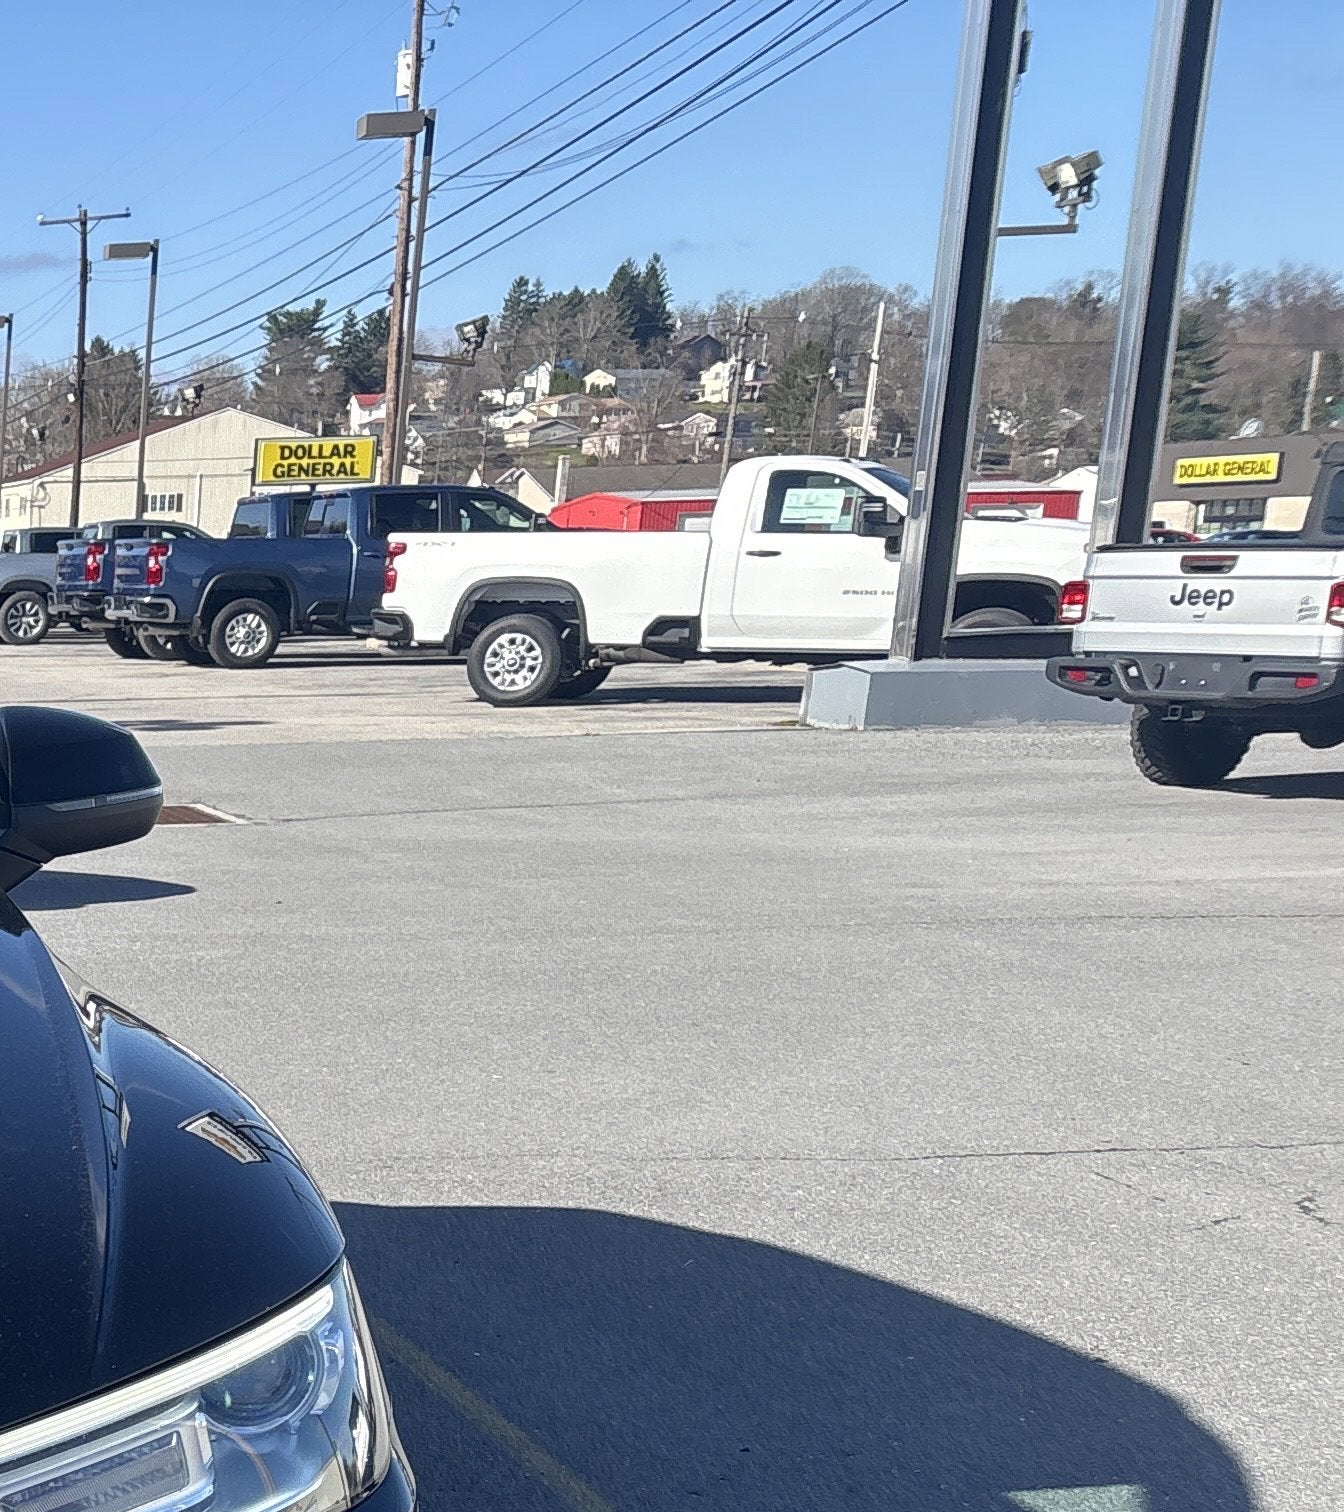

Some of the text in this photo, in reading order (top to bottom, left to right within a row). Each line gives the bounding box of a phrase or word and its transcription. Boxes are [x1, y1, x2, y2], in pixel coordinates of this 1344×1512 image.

[278, 443, 357, 461] DOLLAR
[272, 460, 361, 479] GENERAL
[1179, 459, 1272, 479] DOLLAR GENERAL
[1169, 582, 1235, 611] Jeep
